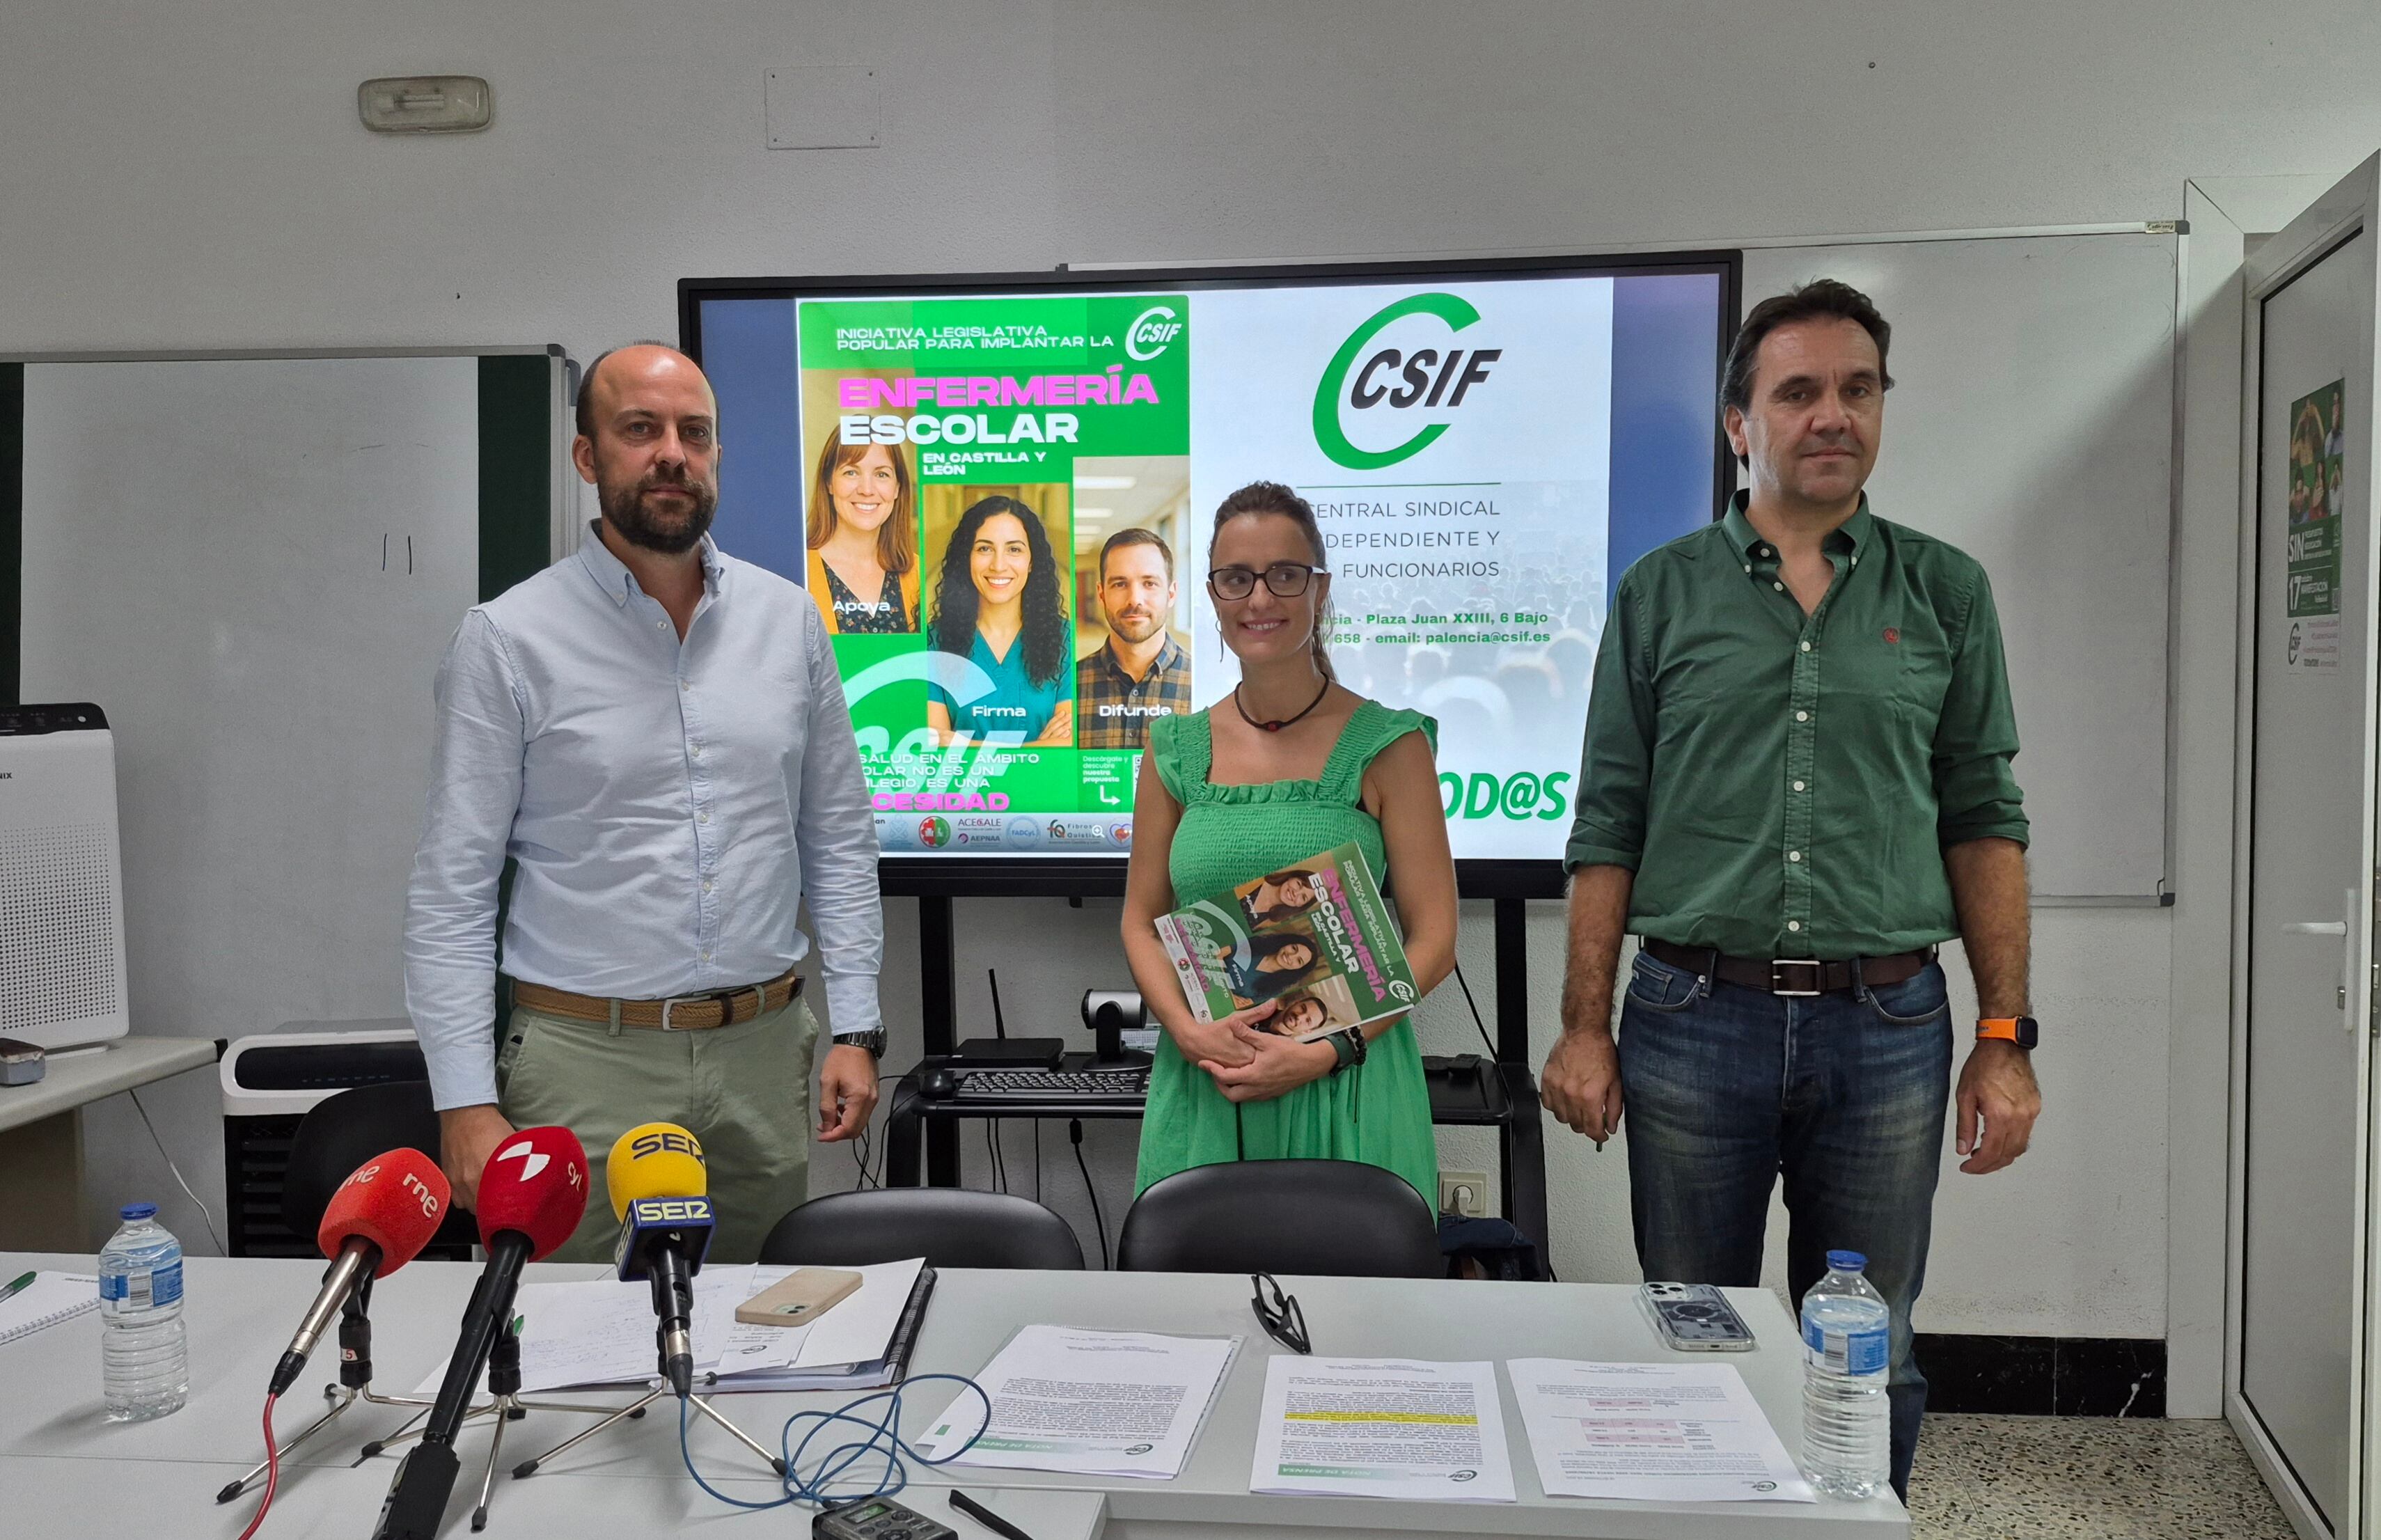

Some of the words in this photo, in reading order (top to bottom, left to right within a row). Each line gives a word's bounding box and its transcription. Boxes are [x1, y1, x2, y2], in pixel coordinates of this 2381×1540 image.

[837, 326, 927, 339] INICIATIVA
[932, 325, 1047, 338] LEGISLATIVA
[837, 338, 920, 351] POPULAR
[926, 338, 976, 349] PARA
[981, 336, 1084, 348] IMPLANTAR
[1090, 335, 1114, 347] LA
[838, 364, 1159, 409] ENFERMERÍA
[1351, 349, 1503, 409] CSIF
[840, 413, 1080, 446] ESCOLAR
[923, 453, 947, 464] EN
[949, 452, 1029, 464] CASTILLA
[1034, 451, 1047, 462] Y
[923, 462, 966, 476] LEÓN
[1312, 503, 1397, 519] ENTRAL
[1405, 501, 1501, 517] SINDICAL
[1487, 531, 1501, 545] Y
[2289, 532, 2304, 563] SIN
[1343, 562, 1500, 579] FUNCIONARIOS
[2289, 575, 2302, 611] 17
[833, 599, 890, 614] Apoya
[1366, 615, 1406, 625] Plaza
[1411, 613, 1447, 624] Juan
[1453, 613, 1495, 626] XXIII,
[1500, 613, 1509, 624] 6
[1514, 613, 1548, 626] Bajo
[1334, 634, 1361, 644] 658
[1375, 633, 1421, 644] email:
[1426, 631, 1551, 645] palencia@csif.es
[973, 705, 1026, 717] Firma
[1099, 704, 1172, 717] Difunde
[860, 753, 913, 764] SALUD
[919, 753, 942, 764] EN
[948, 753, 968, 764] EL
[1083, 755, 1123, 764] Descárgate
[913, 766, 936, 776] NO
[942, 766, 964, 776] ES
[971, 766, 994, 776] UN
[927, 778, 949, 788] ES
[955, 778, 991, 788] UNA
[1083, 776, 1120, 785] propuesta
[1244, 893, 1259, 919] Apoya
[1307, 872, 1361, 975] ESCOLAR
[1319, 867, 1391, 1003] ENFERMERÍA
[1319, 921, 1337, 956] CASTILLA
[1358, 898, 1370, 918] PARA
[1387, 966, 1394, 977] LA
[1231, 964, 1245, 987] Firma
[631, 1133, 705, 1168] SER
[402, 1172, 439, 1218] rne
[638, 1200, 712, 1222] SER
[615, 1211, 634, 1266] SER
[345, 1348, 354, 1360] 5
